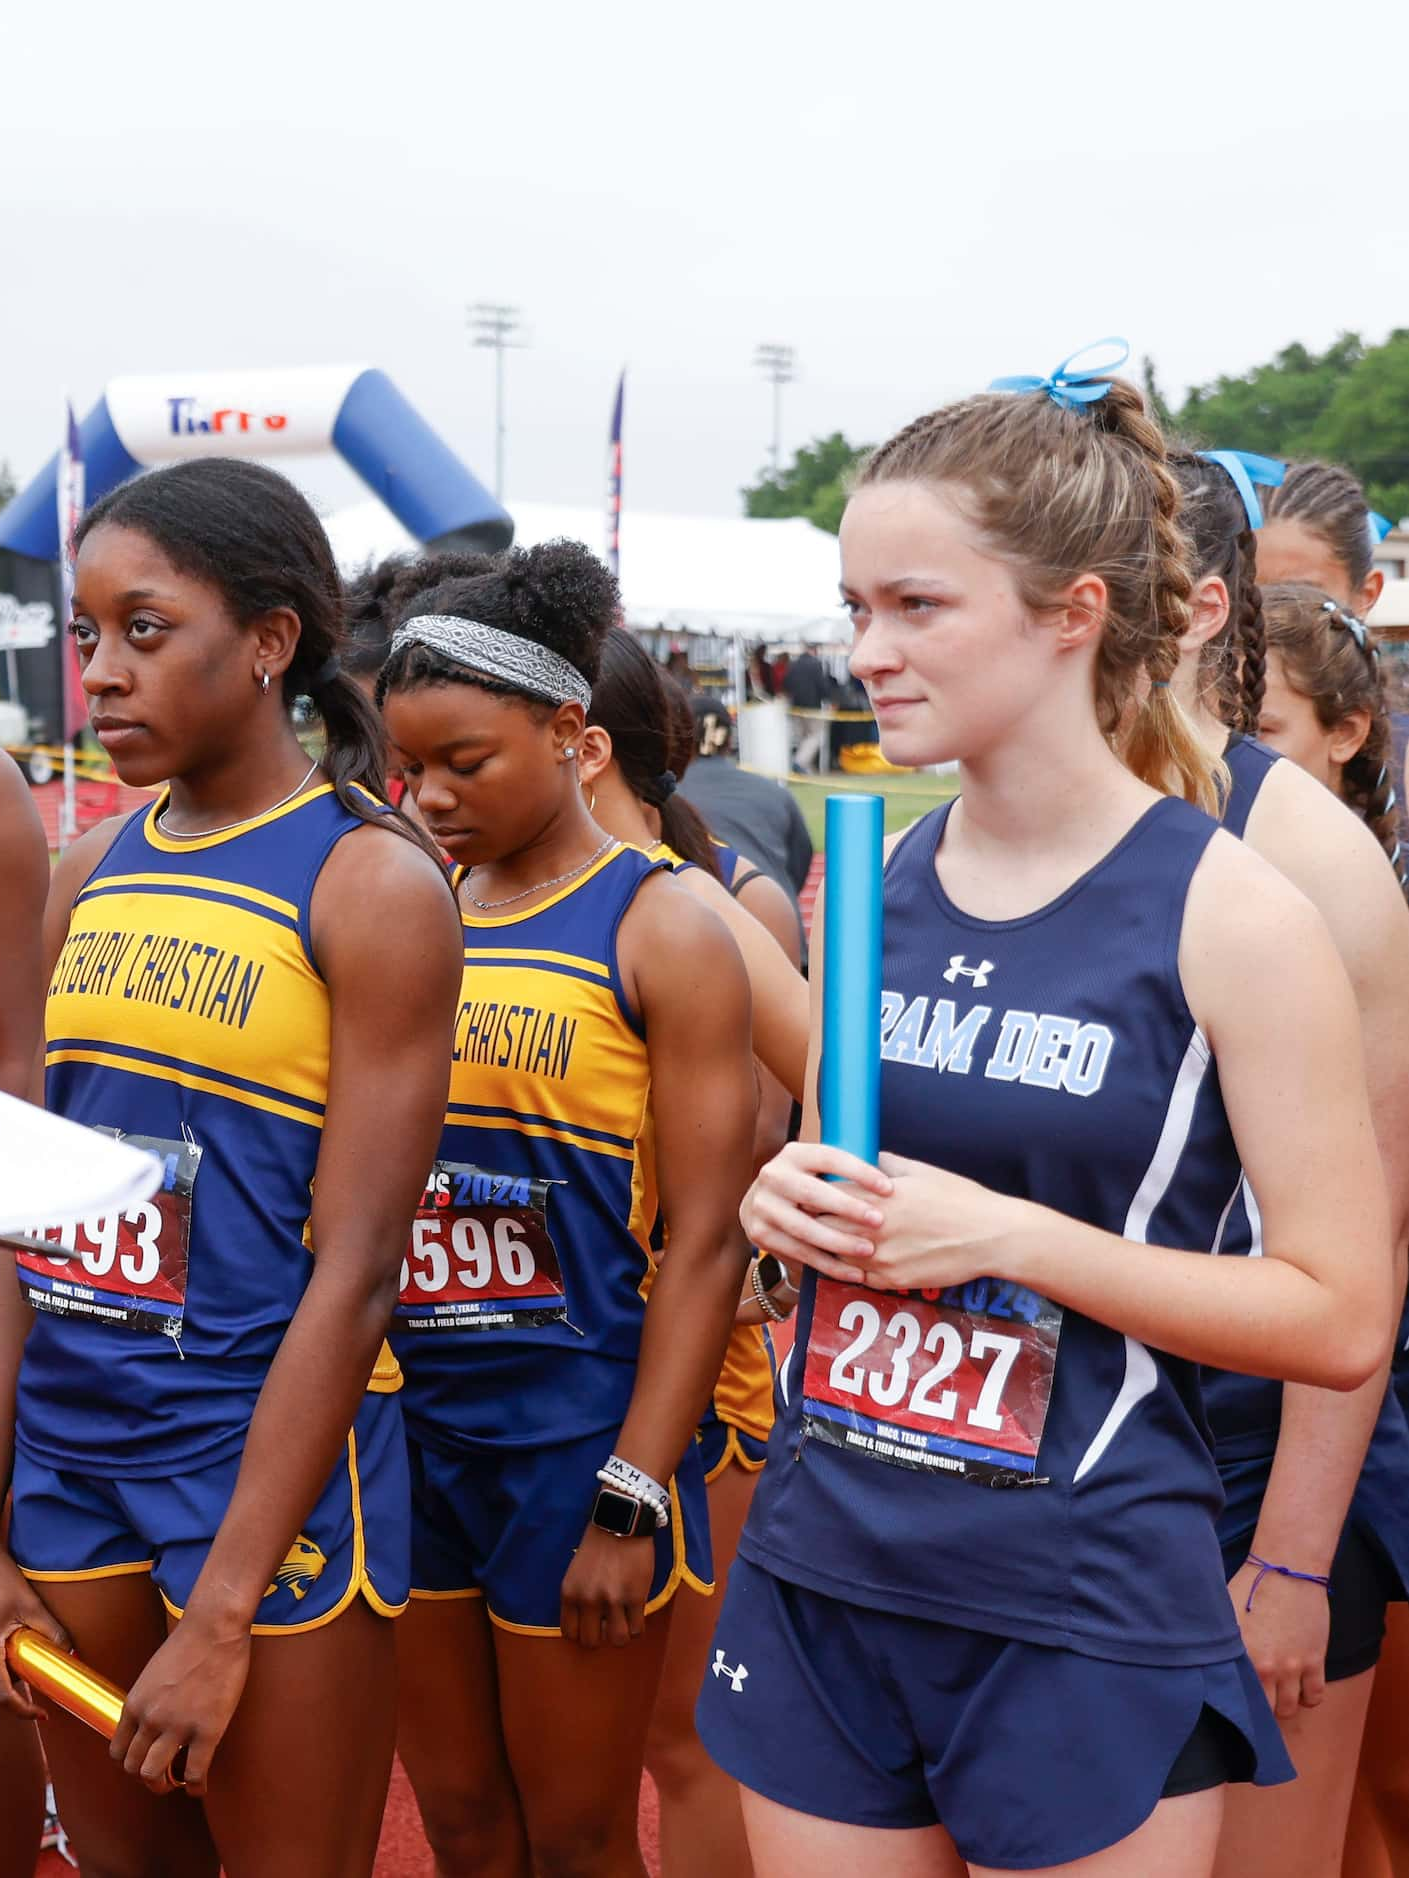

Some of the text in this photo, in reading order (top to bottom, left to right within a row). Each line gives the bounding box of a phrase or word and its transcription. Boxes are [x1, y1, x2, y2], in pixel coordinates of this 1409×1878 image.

[124, 934, 265, 1029] CHRISTIAN
[452, 1002, 577, 1080] CHRISTIAN
[984, 1010, 1114, 1097] DEO
[453, 1174, 531, 1207] 2024
[24, 1199, 163, 1285] 93
[399, 1217, 536, 1293] 596
[69, 1300, 128, 1321] CHAMPIONSHIPS
[408, 1319, 429, 1329] TRACK
[437, 1317, 455, 1328] FIELD
[455, 1313, 514, 1326] CHAMPIONSHIPS
[458, 1303, 480, 1314] TEXAS
[829, 1300, 1022, 1432] 2327
[846, 1430, 867, 1448] TRACK
[874, 1440, 894, 1456] FIELD
[894, 1445, 966, 1473] CHAMPIONSHIPS
[901, 1430, 928, 1449] TEXAS
